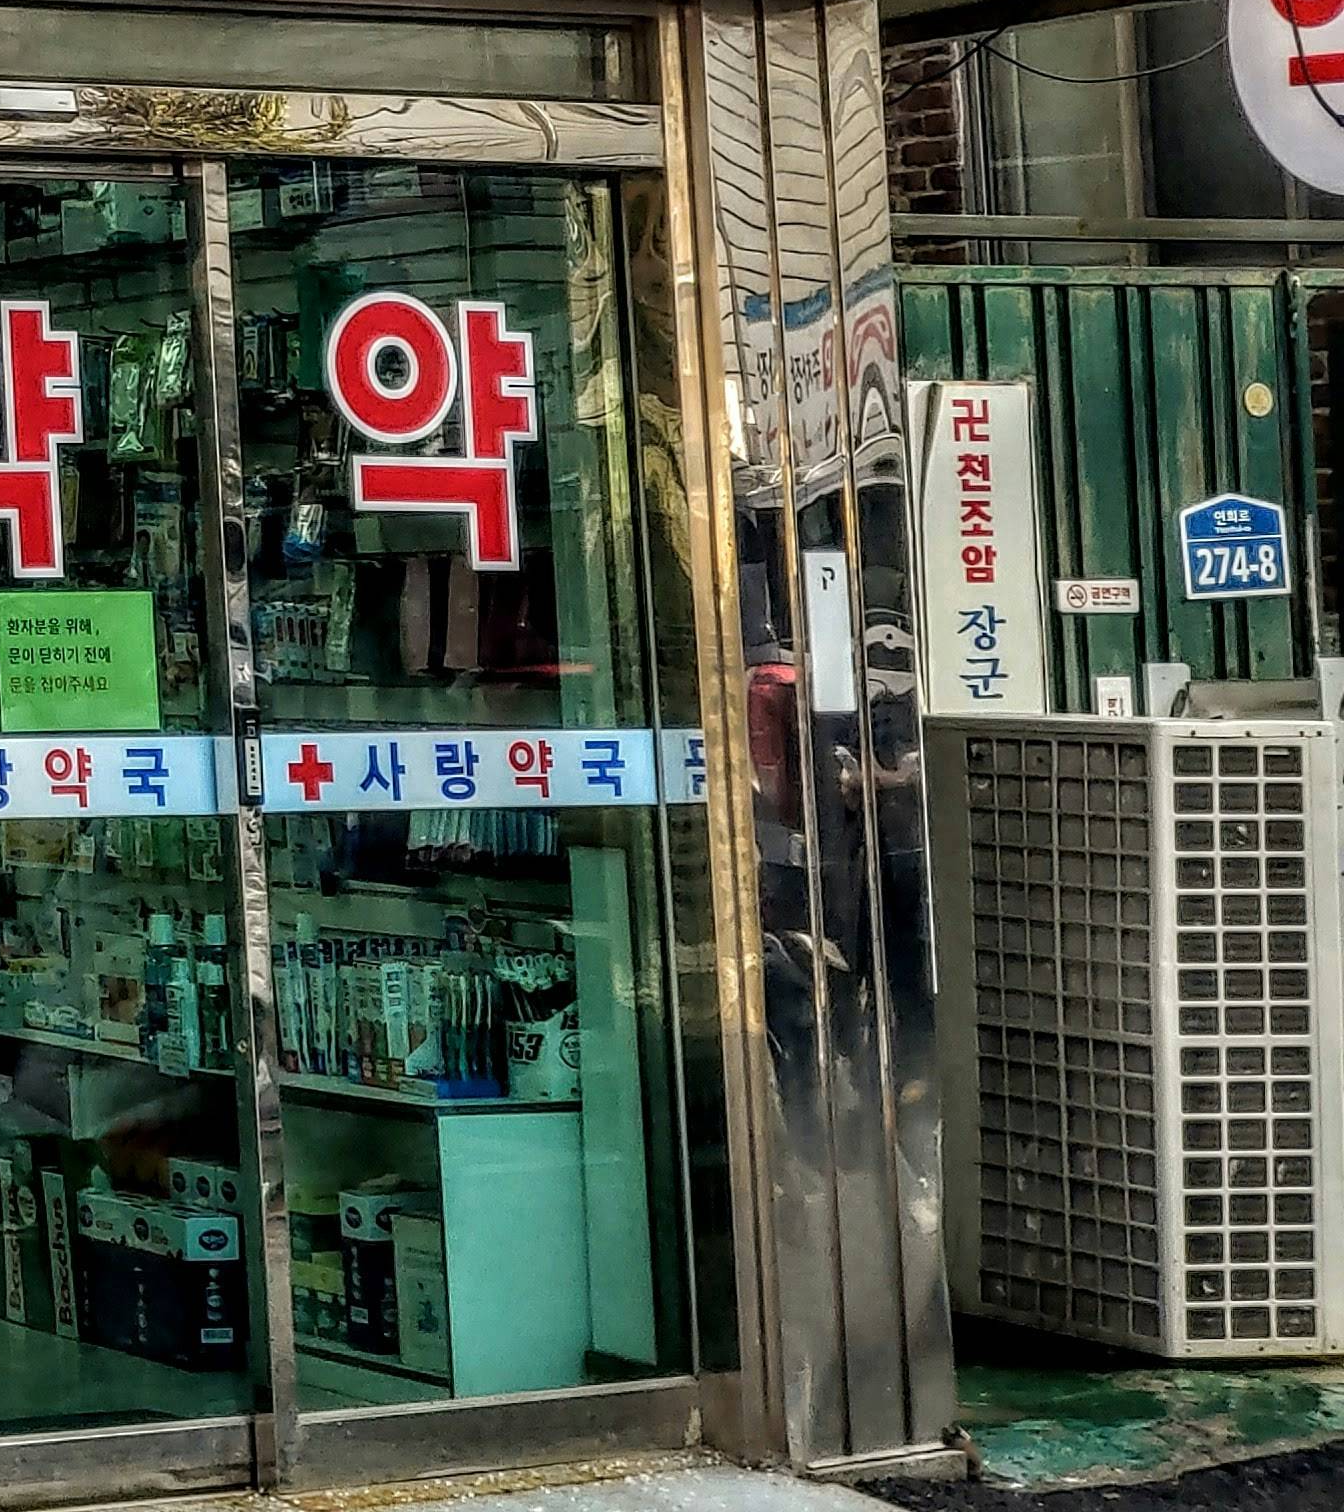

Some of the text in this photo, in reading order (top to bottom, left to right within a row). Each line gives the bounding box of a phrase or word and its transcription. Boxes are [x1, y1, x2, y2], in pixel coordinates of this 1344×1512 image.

[326, 291, 539, 572] 약
[957, 454, 997, 584] 천조암
[1196, 545, 1278, 586] 274-8
[6, 618, 60, 637] 환자분을
[958, 605, 1009, 700] 장군
[8, 645, 112, 665] 문이 닫히기 전에
[10, 675, 36, 695] 문을
[359, 738, 627, 802] 사랑약국
